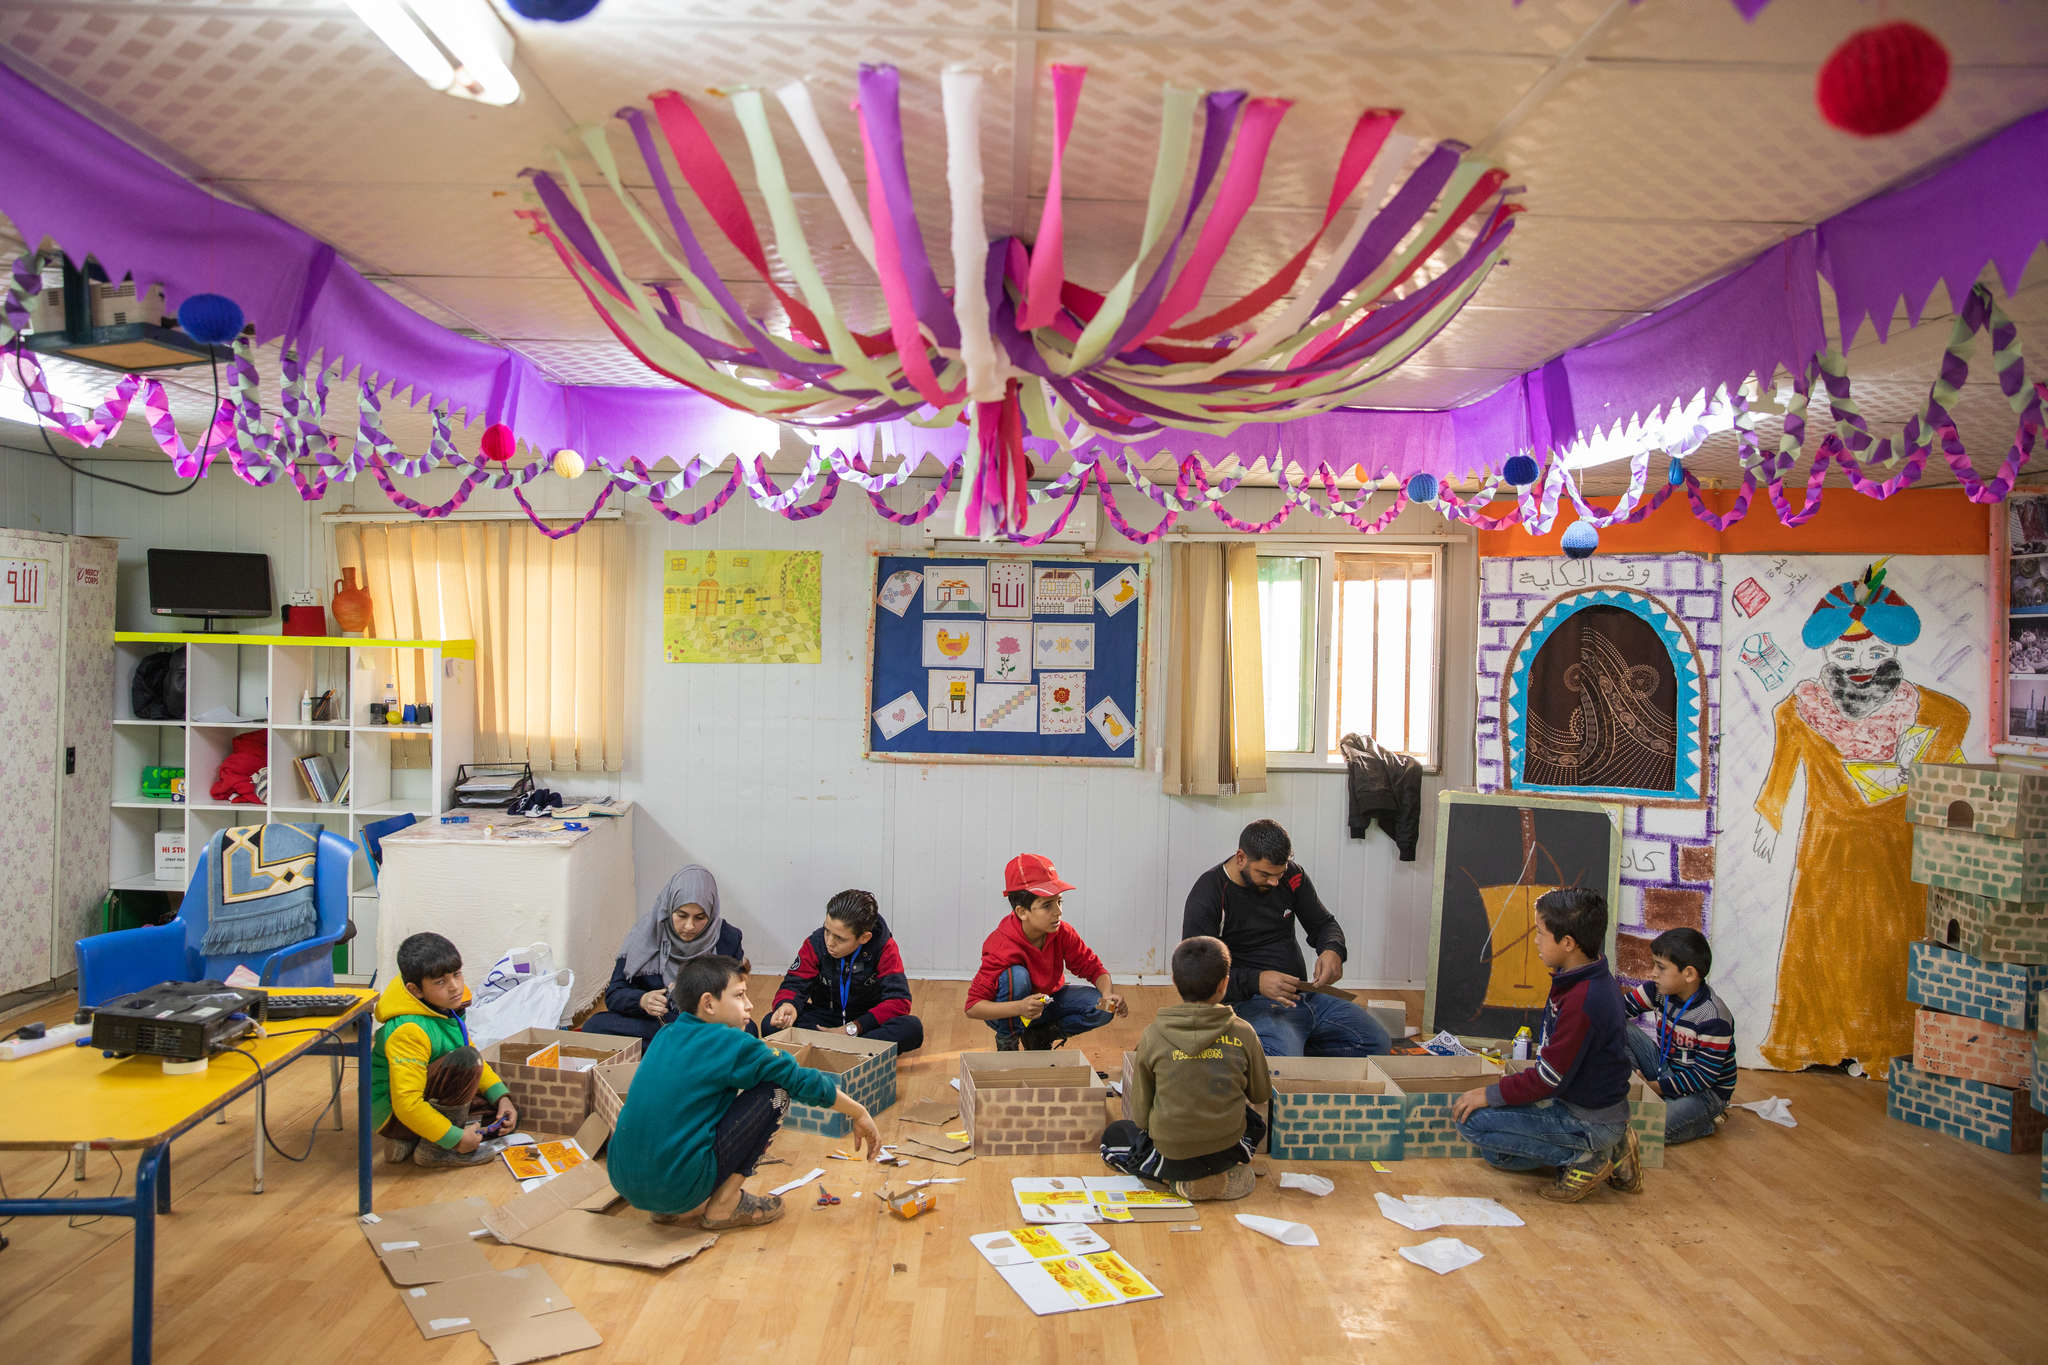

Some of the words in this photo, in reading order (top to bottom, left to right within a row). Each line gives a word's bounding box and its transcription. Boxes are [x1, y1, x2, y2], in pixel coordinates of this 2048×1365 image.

[85, 568, 99, 577] MERCY
[1518, 558, 1595, 592] الحكاية
[1597, 564, 1651, 586] وقت
[84, 576, 99, 585] CORPS
[161, 846, 170, 854] HI
